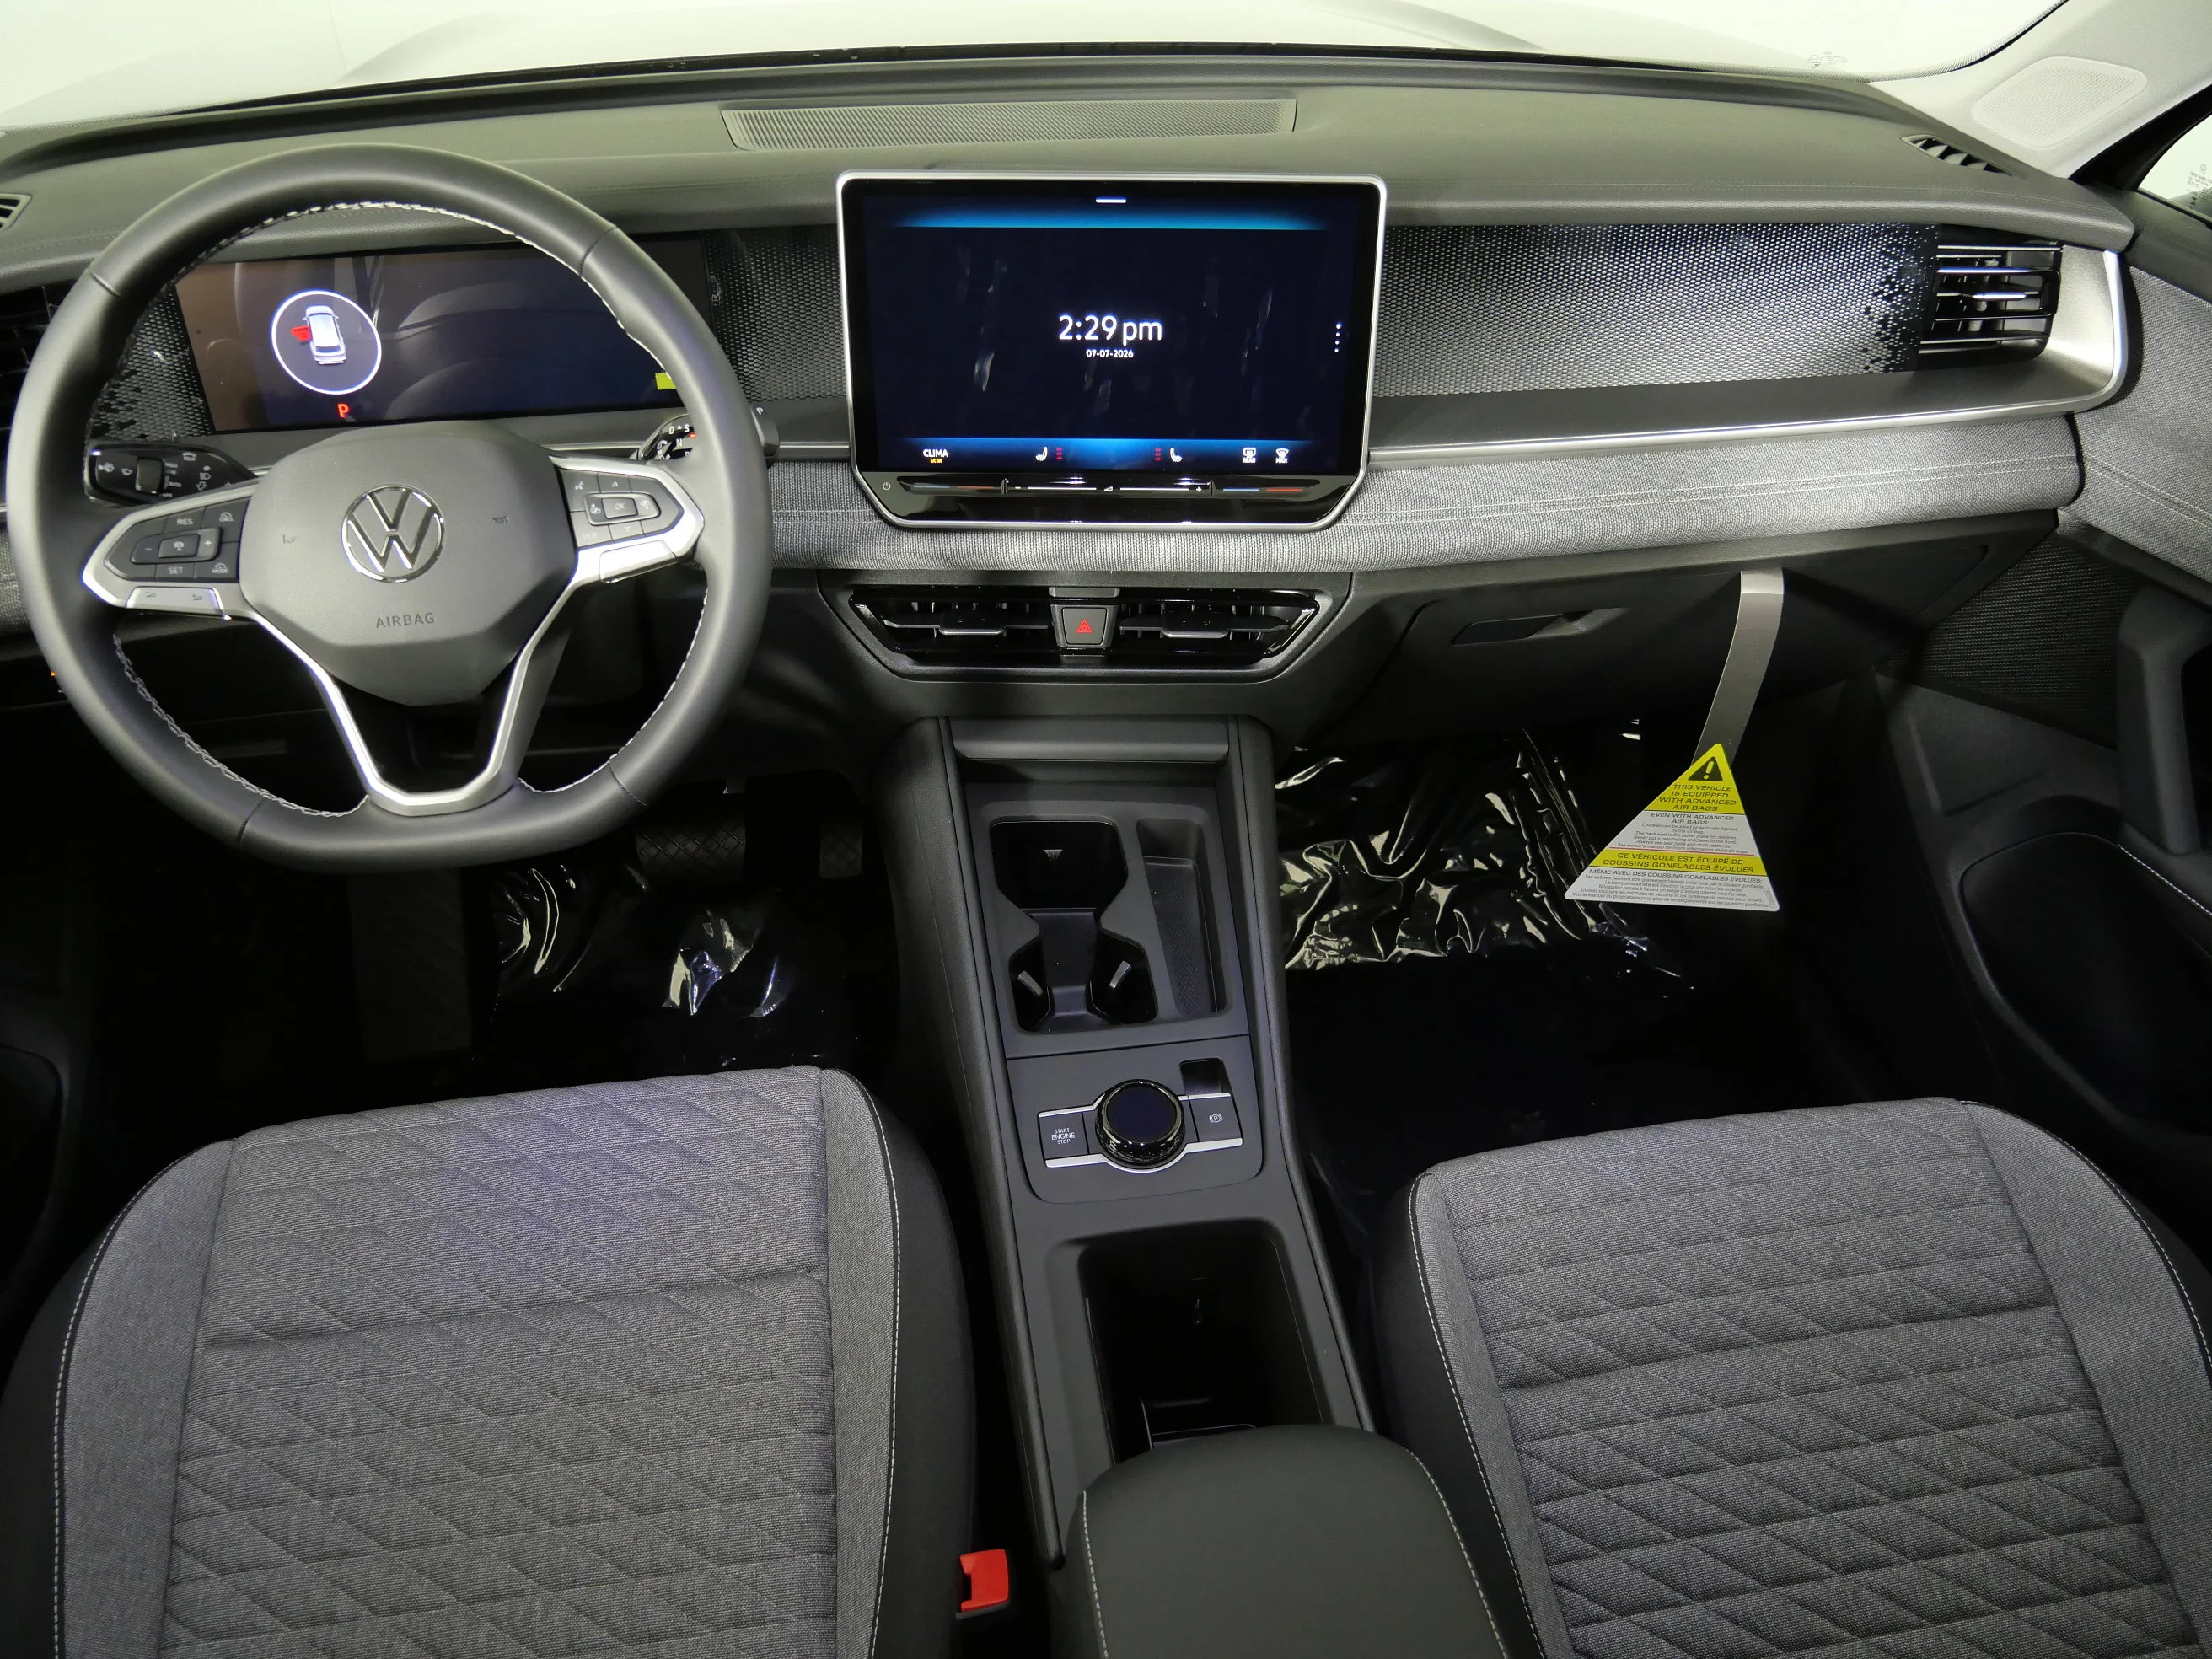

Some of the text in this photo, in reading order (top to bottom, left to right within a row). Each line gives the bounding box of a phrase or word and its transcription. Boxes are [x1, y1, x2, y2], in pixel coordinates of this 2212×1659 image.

[1059, 314, 1162, 346] 2:29 pm
[1086, 349, 1134, 358] 07-07-2026
[337, 403, 350, 418] P
[756, 407, 763, 415] P
[668, 426, 675, 435] D
[684, 424, 690, 433] S
[676, 438, 682, 447] N
[923, 448, 949, 457] CLIMA
[376, 612, 435, 629] AIRBAG
[1632, 852, 1675, 861] VÉHICULE
[1697, 856, 1729, 864] ÉQUIPÉ
[1652, 862, 1711, 870] GONFLABLES
[1713, 864, 1754, 872] ÉVOLUÉS
[1051, 1132, 1075, 1140] ENGINE
